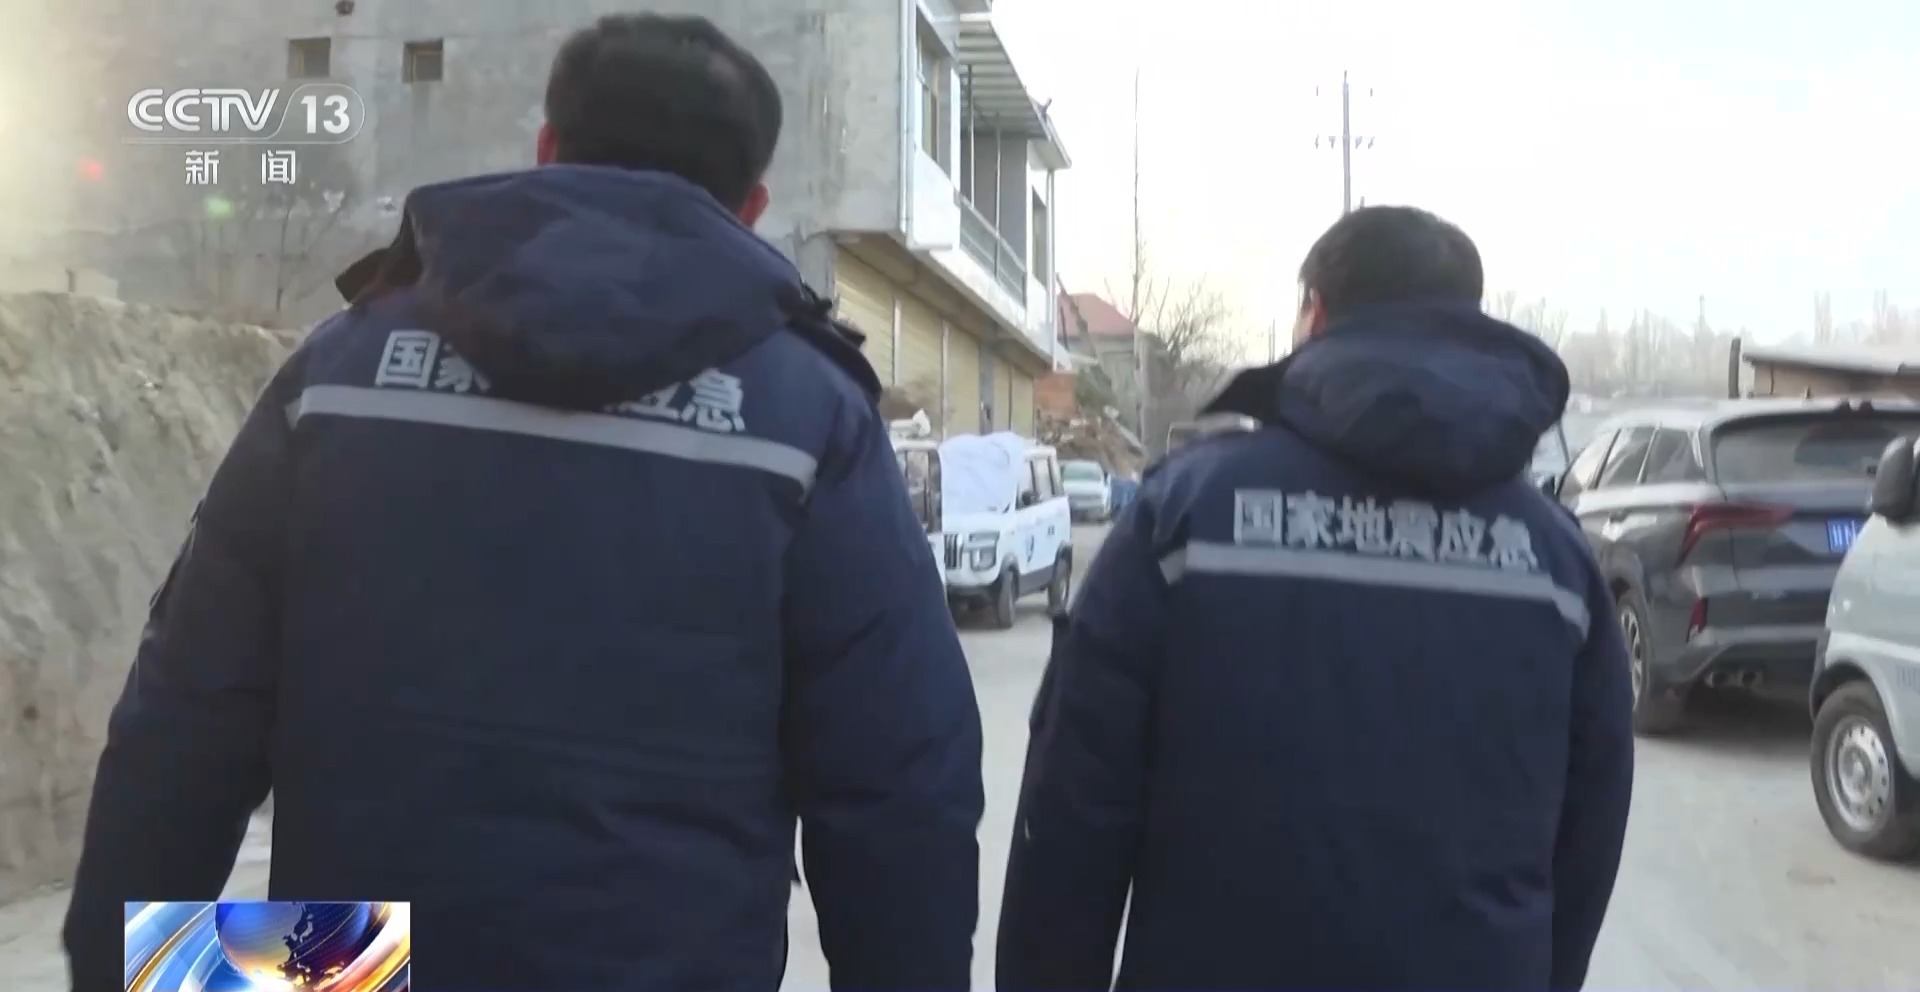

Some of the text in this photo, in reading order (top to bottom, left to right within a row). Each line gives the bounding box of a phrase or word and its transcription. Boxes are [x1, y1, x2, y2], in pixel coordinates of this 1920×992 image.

[375, 329, 745, 433] 国家急
[1233, 488, 1539, 572] 国家地震应急
